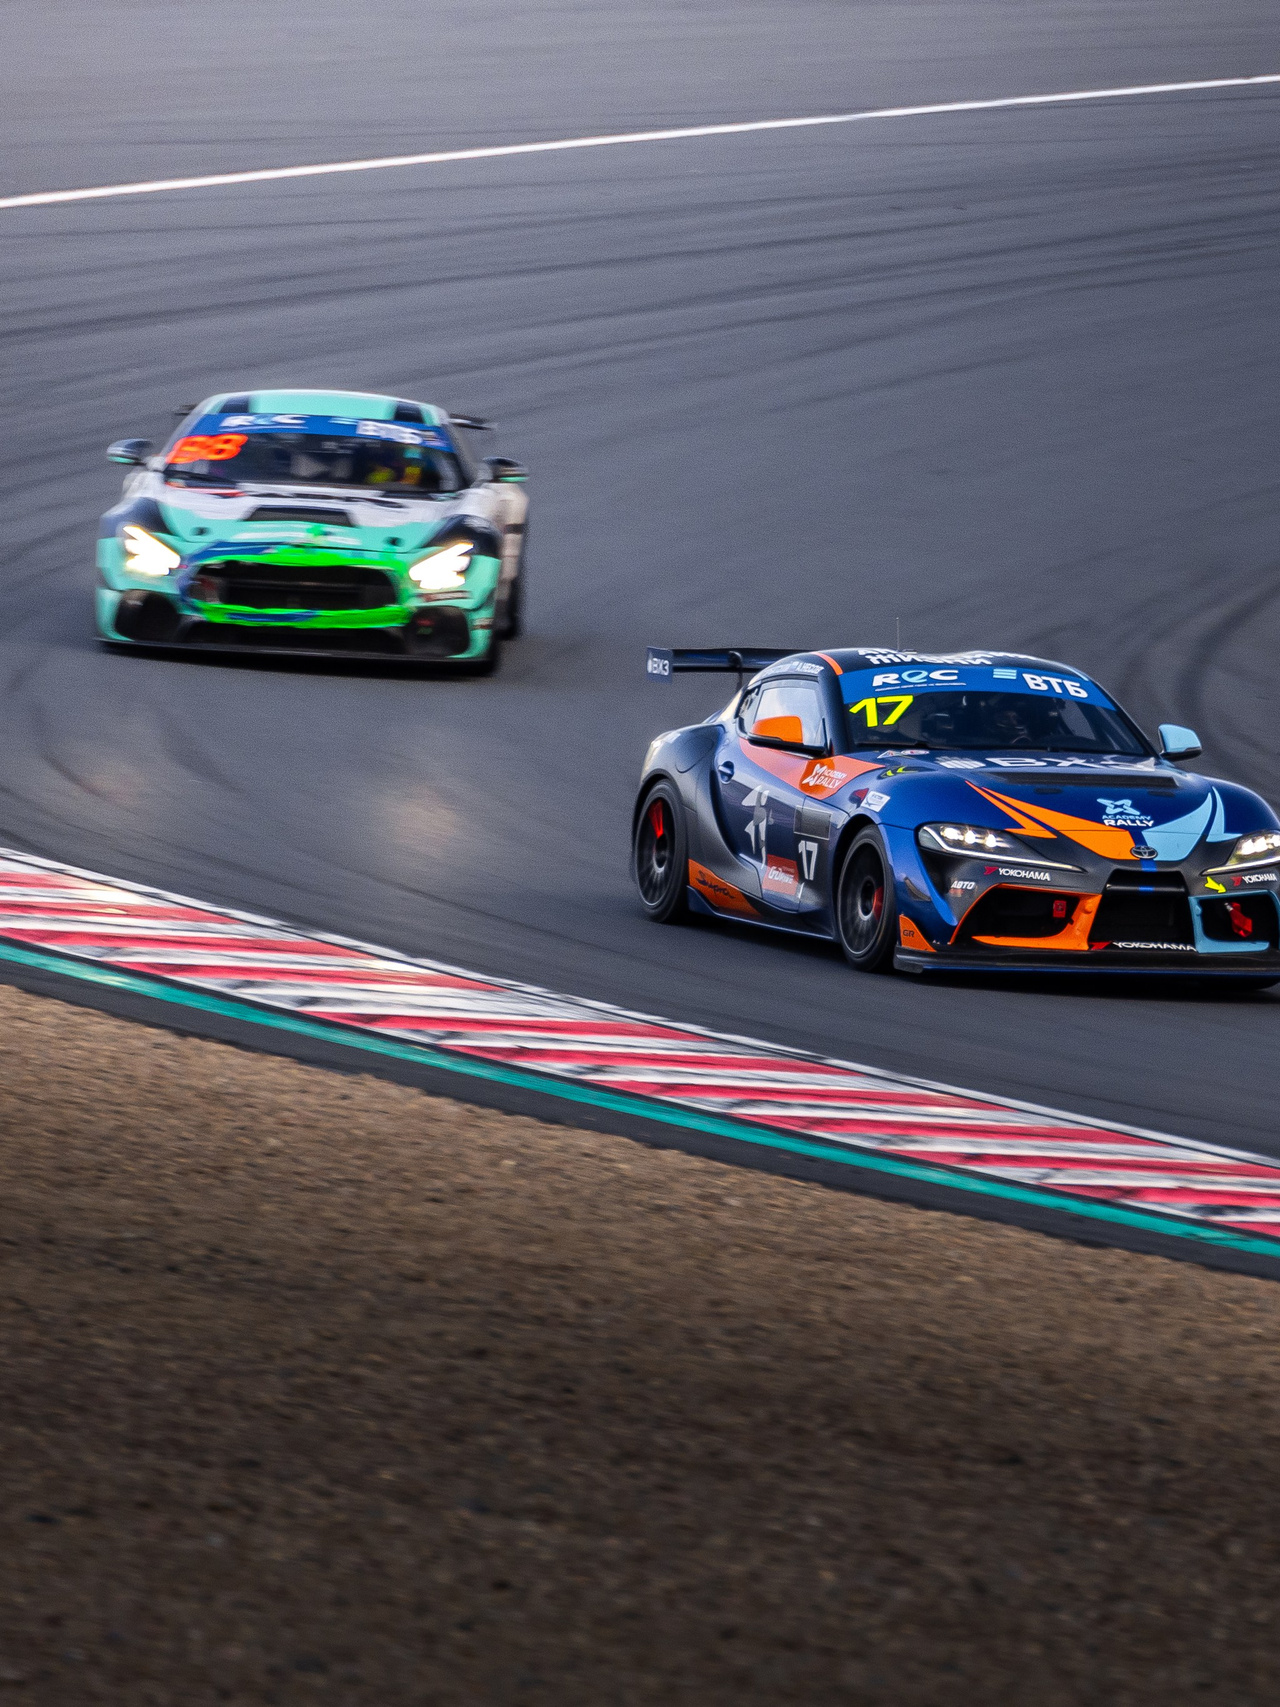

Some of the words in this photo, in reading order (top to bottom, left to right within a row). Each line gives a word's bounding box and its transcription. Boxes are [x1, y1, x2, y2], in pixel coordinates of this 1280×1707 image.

[1022, 673, 1088, 698] ВТБ
[849, 695, 913, 727] 17
[815, 776, 842, 788] RALLY
[1103, 819, 1154, 827] RALLY
[798, 840, 818, 880] 17
[998, 867, 1051, 882] YOKOHAMA
[1242, 873, 1277, 884] YOKOHAMA
[902, 929, 915, 938] GR
[1112, 941, 1197, 952] YOKOHAMA
